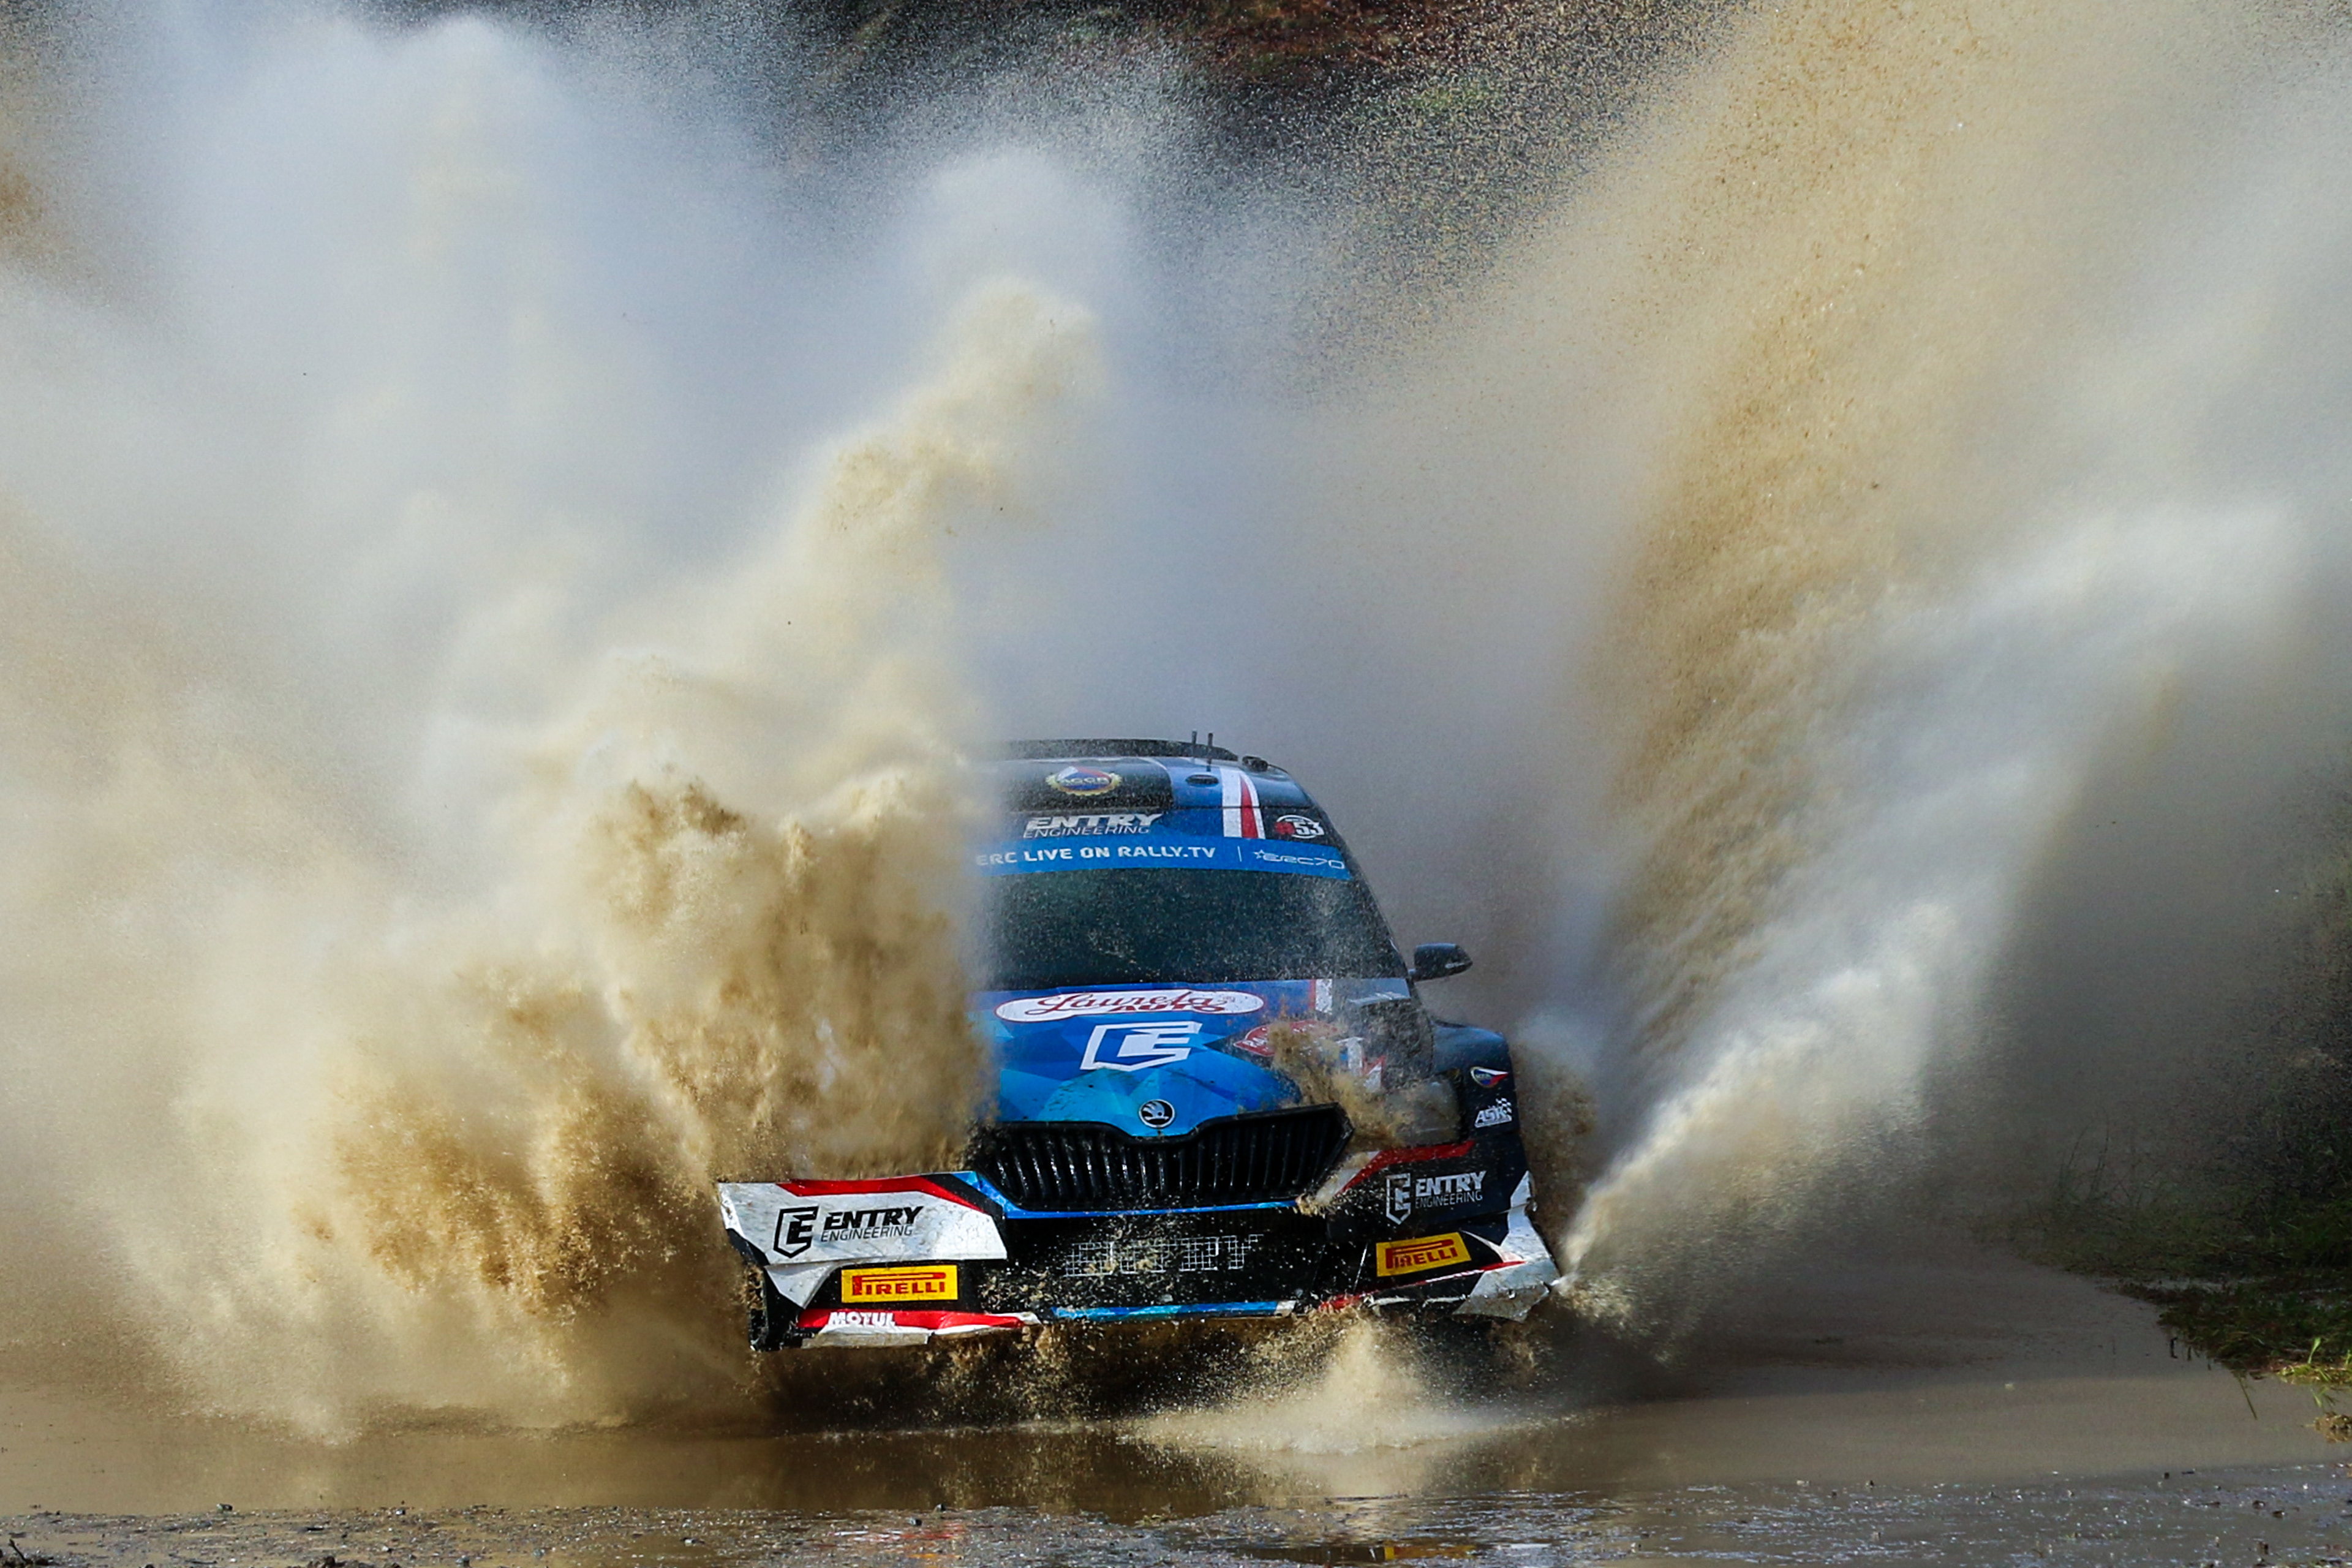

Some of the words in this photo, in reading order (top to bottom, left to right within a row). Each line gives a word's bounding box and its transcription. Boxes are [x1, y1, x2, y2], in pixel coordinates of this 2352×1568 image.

[1023, 825, 1150, 839] ENGINEERING
[1026, 813, 1163, 832] ENTRY
[976, 852, 1017, 866] ERC
[1023, 848, 1073, 862] LIVE
[1080, 846, 1110, 859] ON
[1117, 846, 1216, 858] RALLY.TV
[1415, 1170, 1487, 1197] ENTRY
[1415, 1189, 1483, 1209] ENGINEERING
[824, 1206, 924, 1231] ENTRY
[821, 1225, 913, 1242] ENGINEERING
[1385, 1239, 1458, 1270] PIRELLI
[852, 1272, 946, 1296] PIRELLI
[828, 1312, 896, 1326] MOTUL
